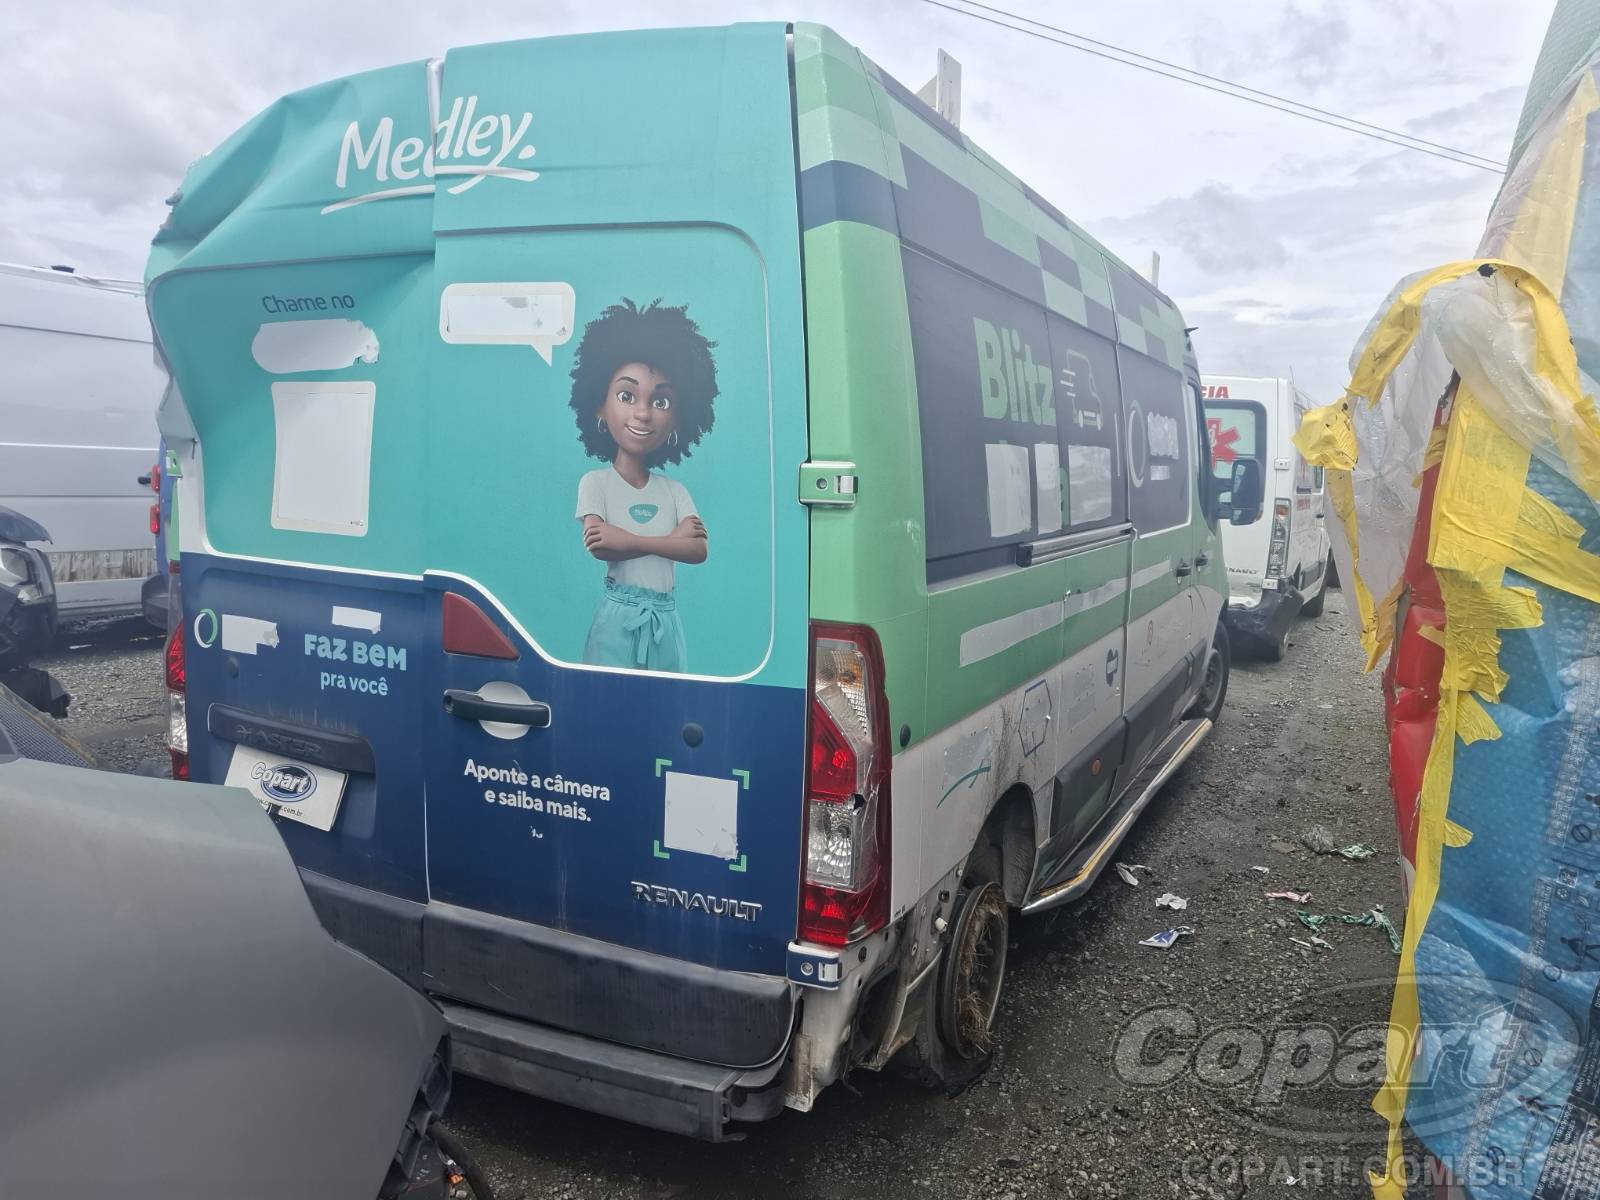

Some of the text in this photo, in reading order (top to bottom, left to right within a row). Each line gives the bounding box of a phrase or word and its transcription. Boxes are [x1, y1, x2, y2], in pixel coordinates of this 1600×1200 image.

[261, 294, 355, 314] Chame no
[973, 317, 1057, 426] Blitz
[320, 671, 389, 696] pra você
[251, 761, 308, 793] Copart
[464, 758, 611, 801] Aponte a câmera
[484, 789, 592, 823] e saiba mais.
[630, 881, 762, 922] RENAULT
